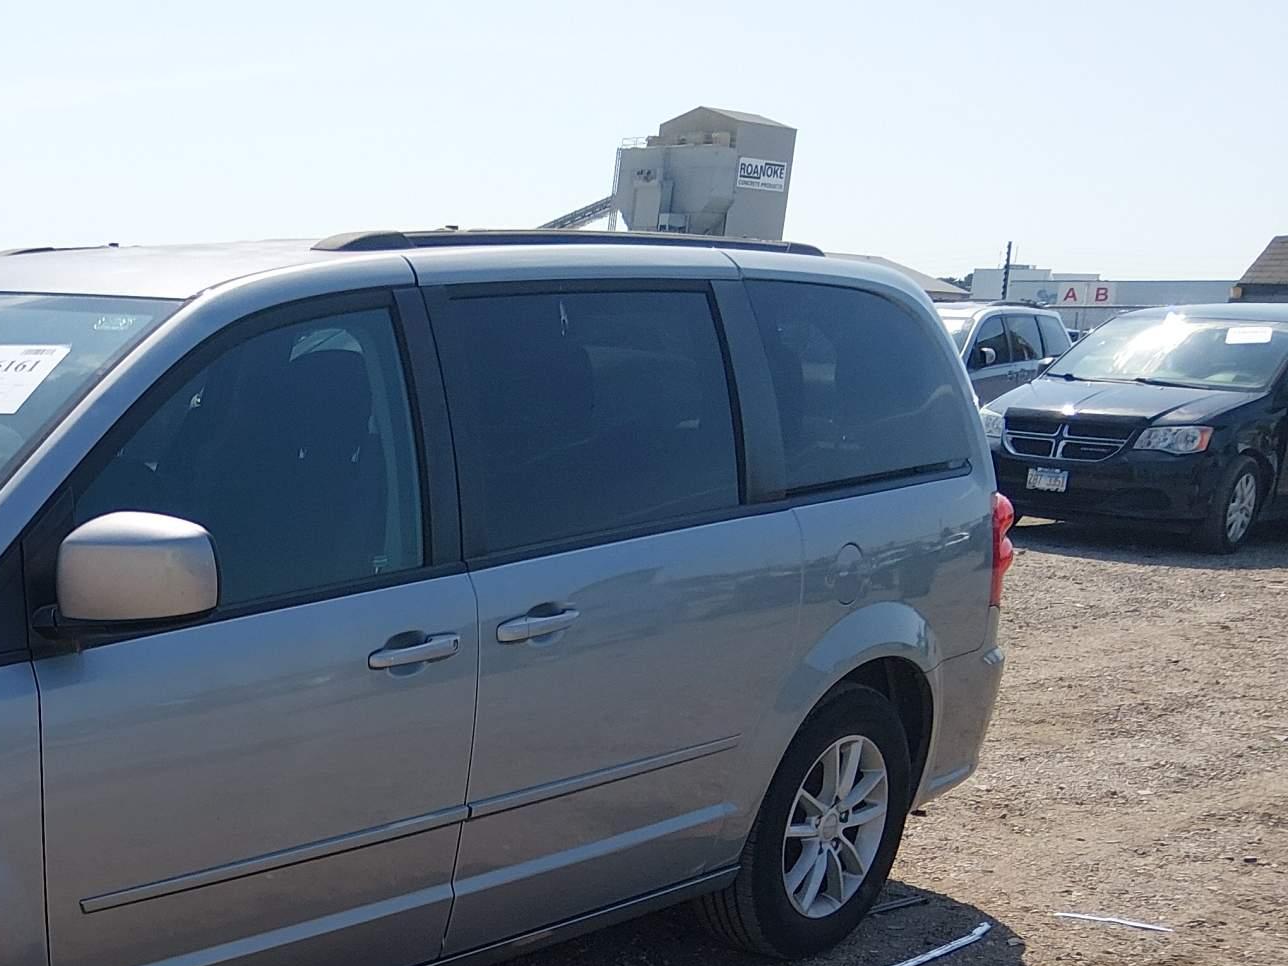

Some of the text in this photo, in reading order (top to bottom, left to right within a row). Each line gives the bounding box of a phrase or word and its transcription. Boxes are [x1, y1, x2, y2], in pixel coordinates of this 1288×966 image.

[740, 163, 785, 180] ROANOKE
[1063, 287, 1109, 302] A B
